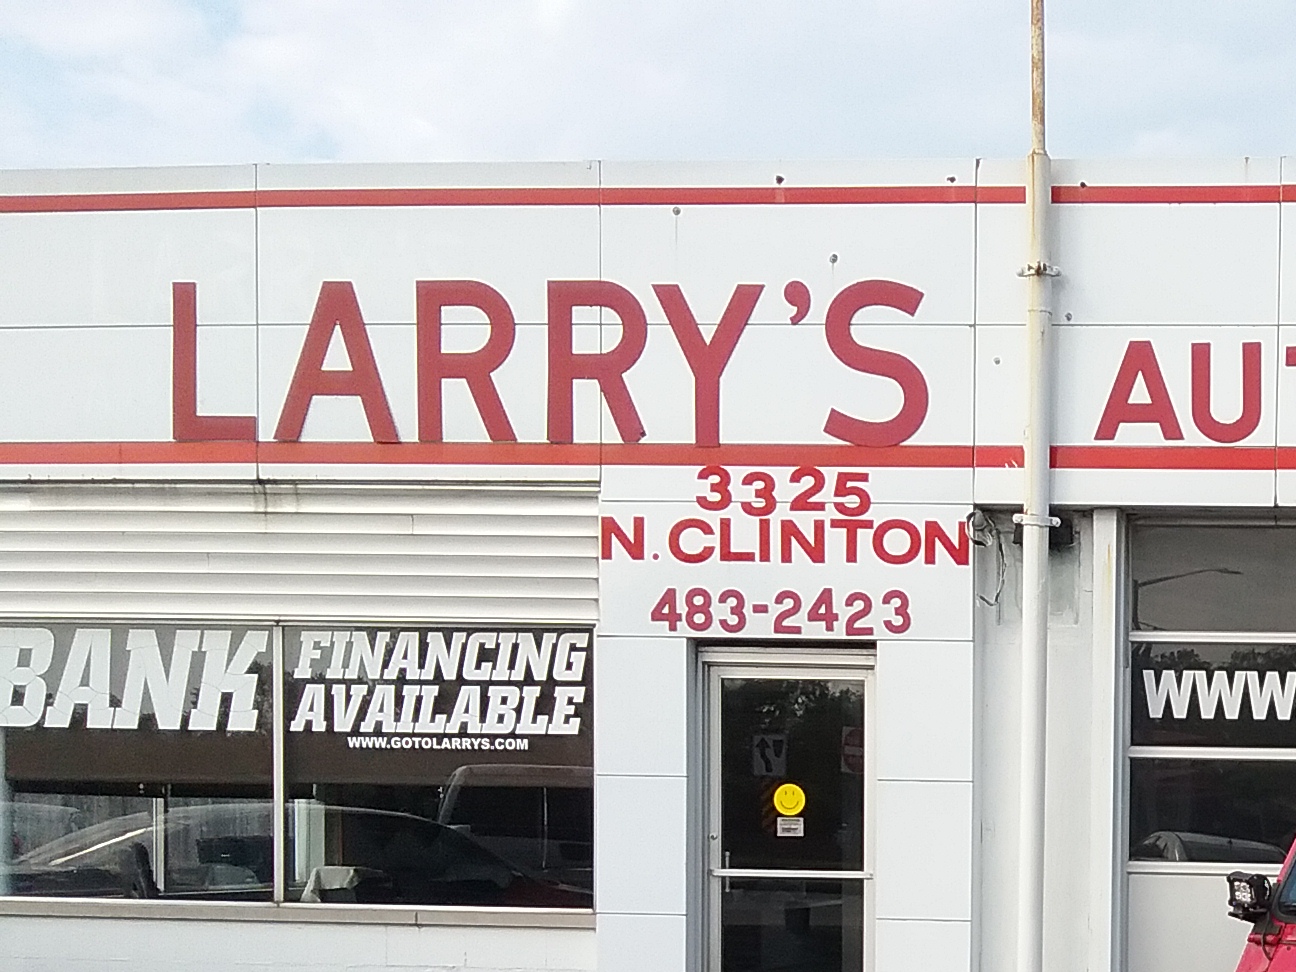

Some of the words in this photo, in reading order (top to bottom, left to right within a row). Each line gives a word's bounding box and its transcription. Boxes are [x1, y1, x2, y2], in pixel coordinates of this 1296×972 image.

[171, 279, 931, 447] LARRY'S
[695, 464, 872, 517] 3325
[650, 587, 912, 637] 483-2423
[0, 627, 269, 731] BANK
[293, 631, 589, 681] FINANCING
[289, 683, 586, 735] AVAILABLE
[347, 736, 529, 750] WWW.GOTOLARRYS.COM
